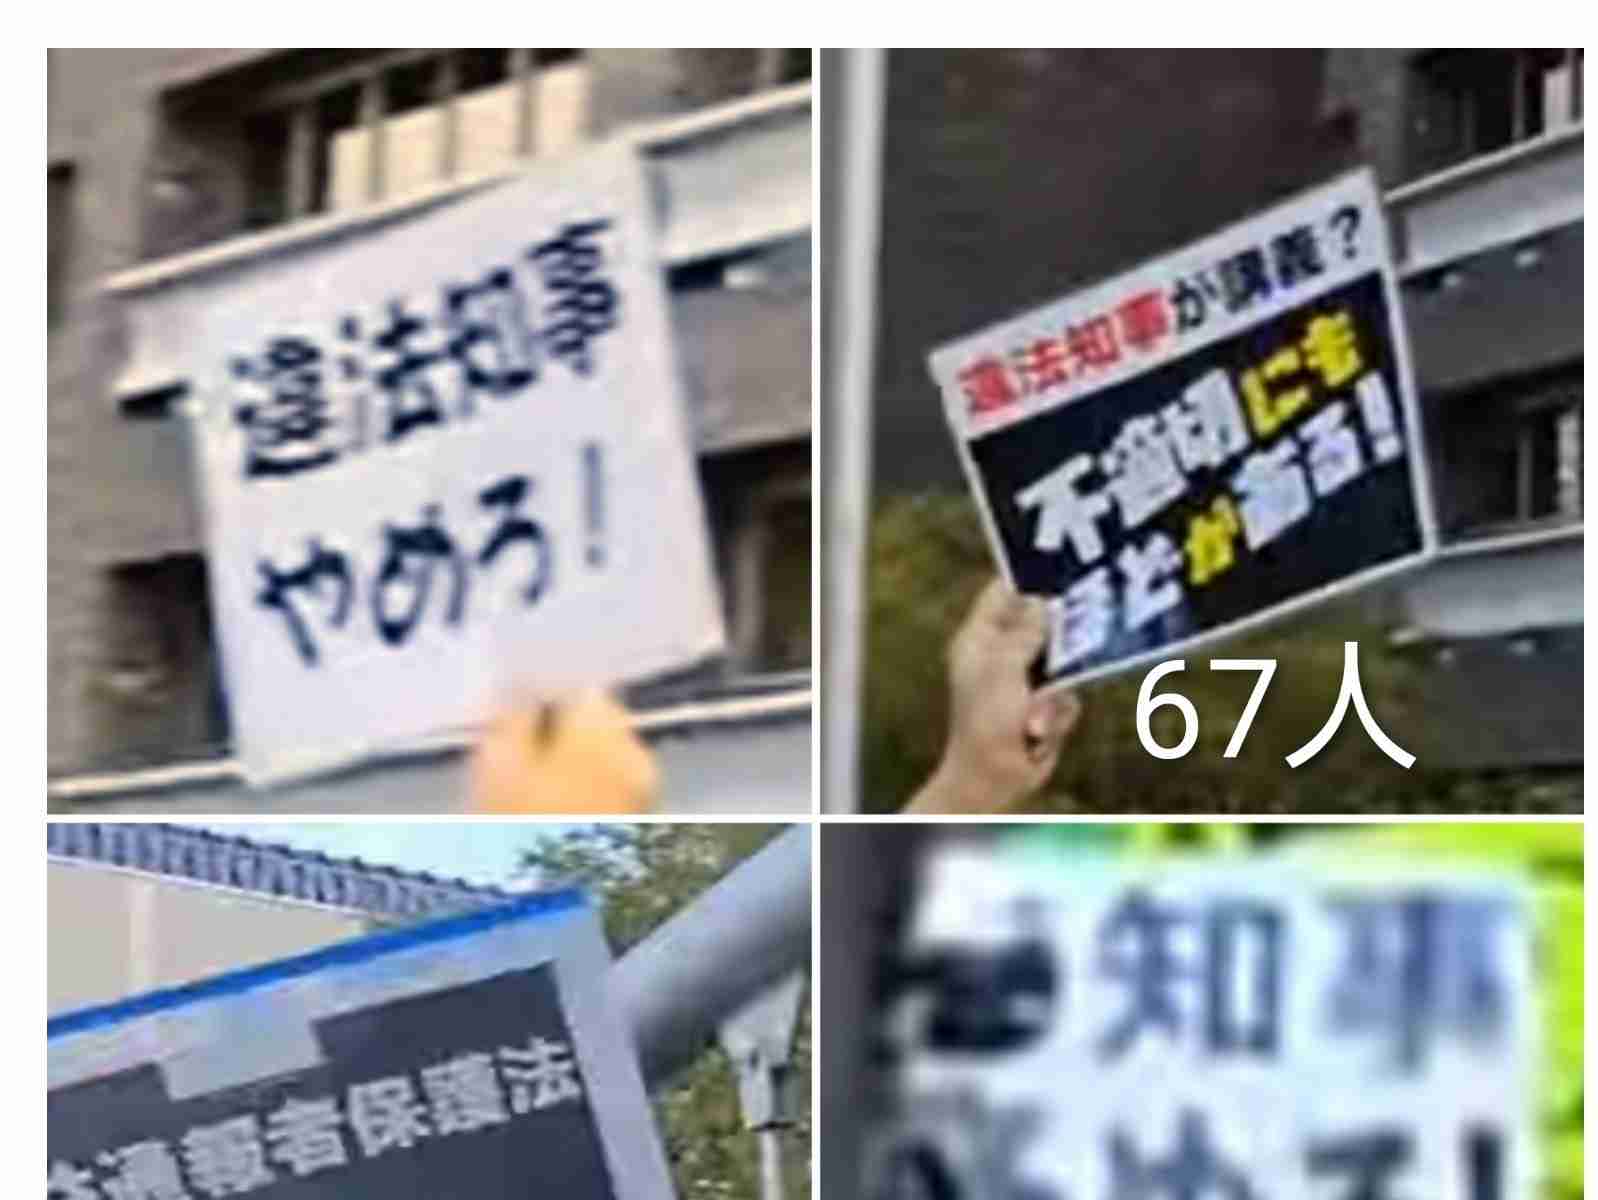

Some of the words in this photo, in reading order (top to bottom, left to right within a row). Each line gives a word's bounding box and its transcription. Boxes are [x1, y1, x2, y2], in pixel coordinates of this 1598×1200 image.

[229, 215, 617, 479] 違法知事
[255, 441, 607, 667] やめろ!
[1000, 886, 1510, 1082] 知事
